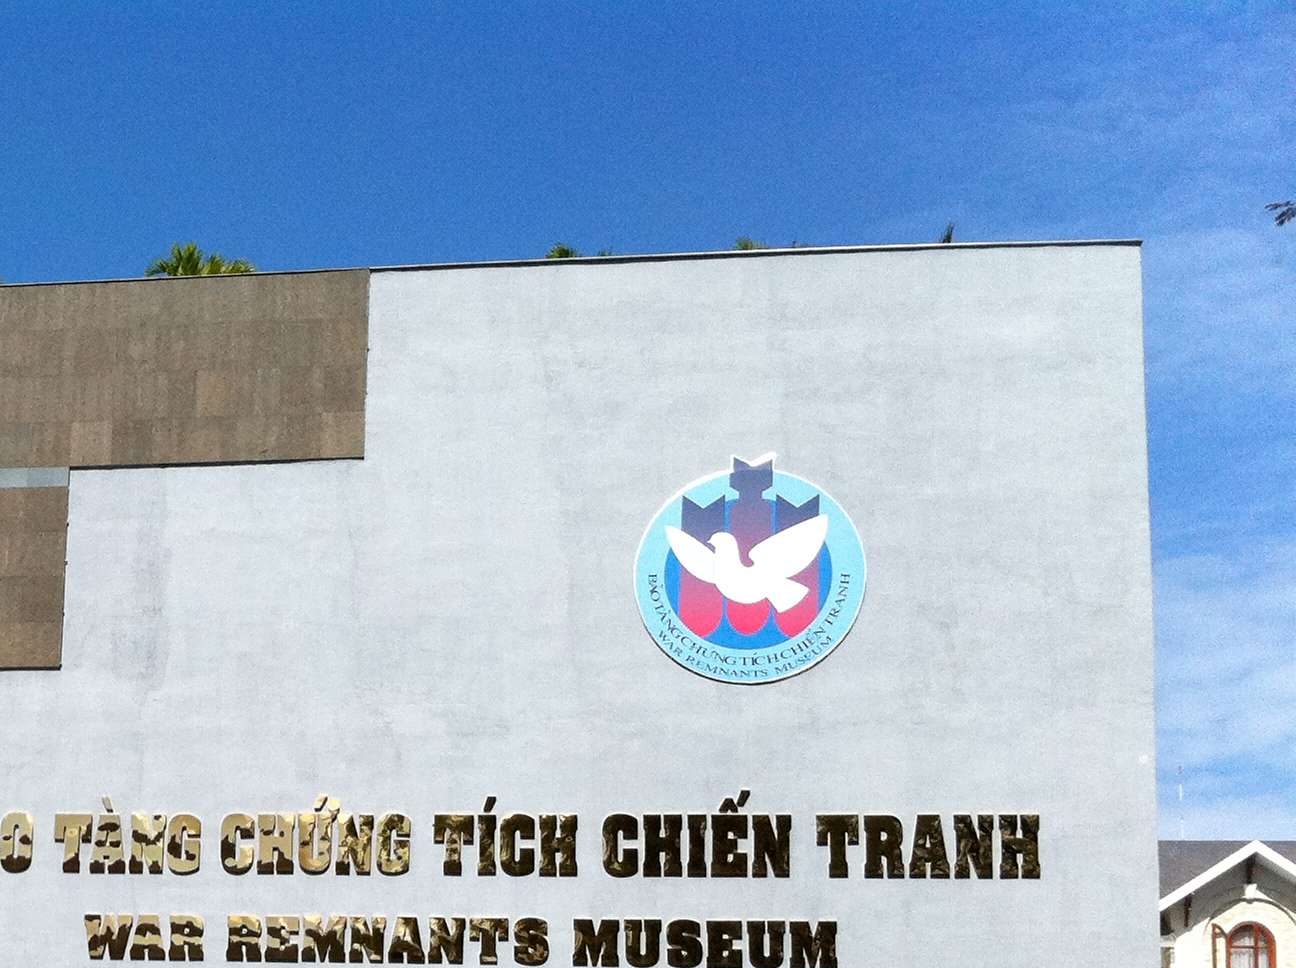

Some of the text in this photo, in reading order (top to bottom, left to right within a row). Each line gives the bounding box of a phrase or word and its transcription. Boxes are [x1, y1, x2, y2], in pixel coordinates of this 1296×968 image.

[824, 573, 851, 625] TRANH
[658, 630, 833, 678] WAR REMNANTS MUSEUM
[54, 796, 202, 875] TÀNG
[219, 792, 412, 876] CHỨNG
[433, 796, 579, 878] TÍCH
[601, 790, 792, 879] CHIẾN
[816, 813, 1042, 879] TRANH
[84, 914, 204, 962] WAR
[225, 914, 549, 966] REMNANTS
